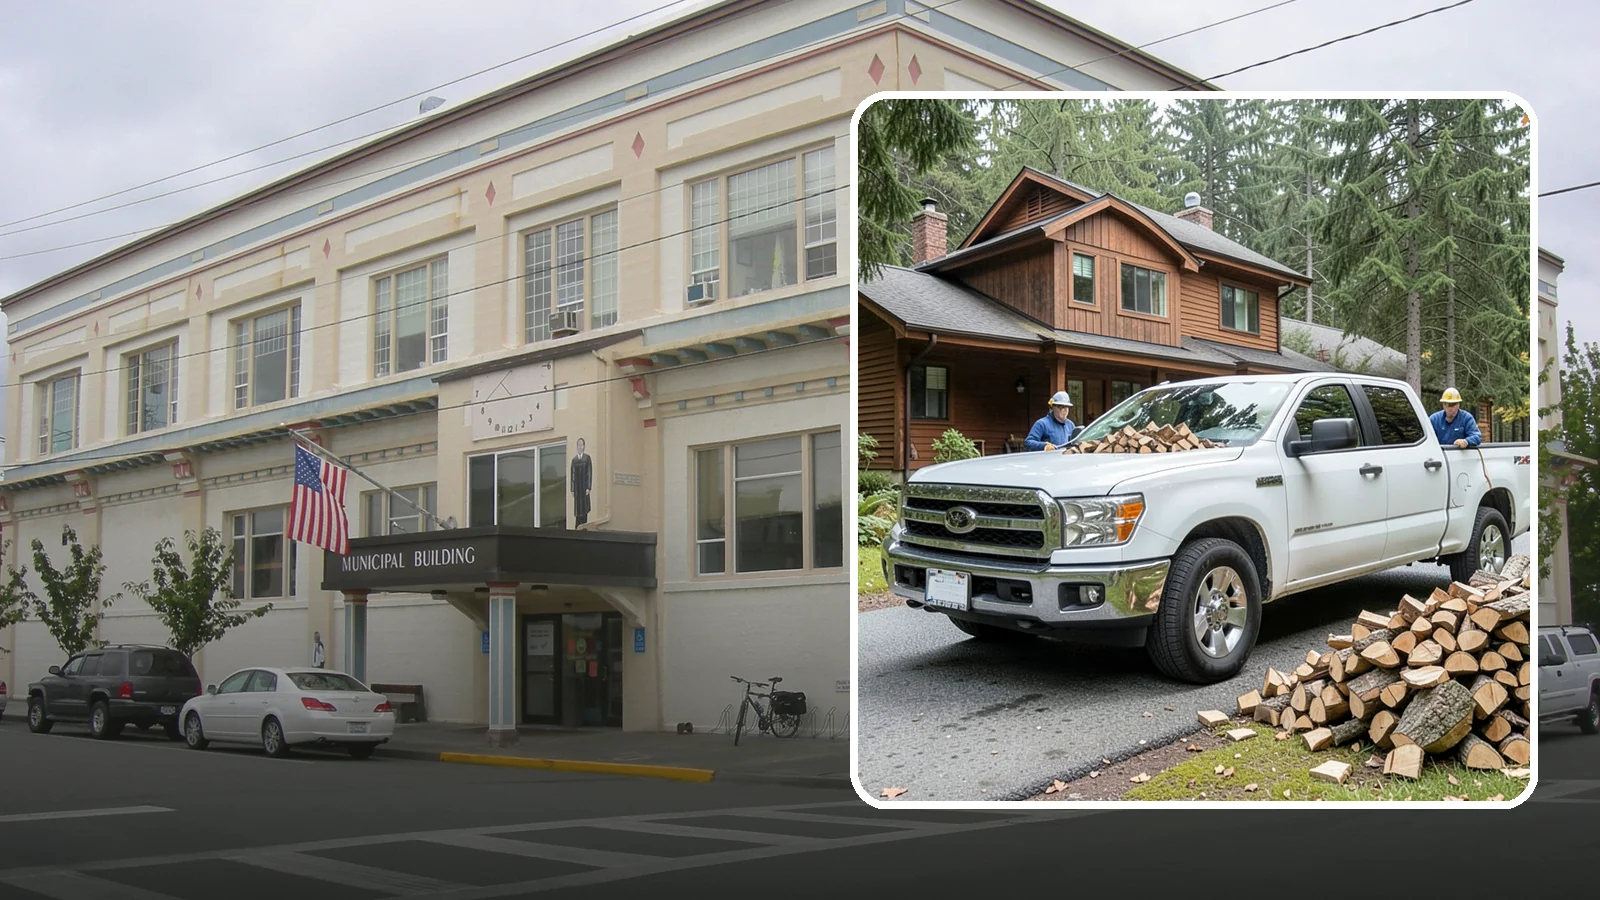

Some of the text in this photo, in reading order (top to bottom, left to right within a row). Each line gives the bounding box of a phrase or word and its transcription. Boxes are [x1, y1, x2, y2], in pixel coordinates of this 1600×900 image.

[475, 390, 479, 398] 7
[480, 407, 485, 415] 8
[487, 417, 493, 426] 9
[494, 423, 500, 432] 10
[507, 425, 513, 434] 12
[521, 420, 526, 429] 2
[528, 414, 533, 422] 3
[536, 402, 540, 410] 4
[341, 546, 475, 572] MUNICIPAL BUILDING
